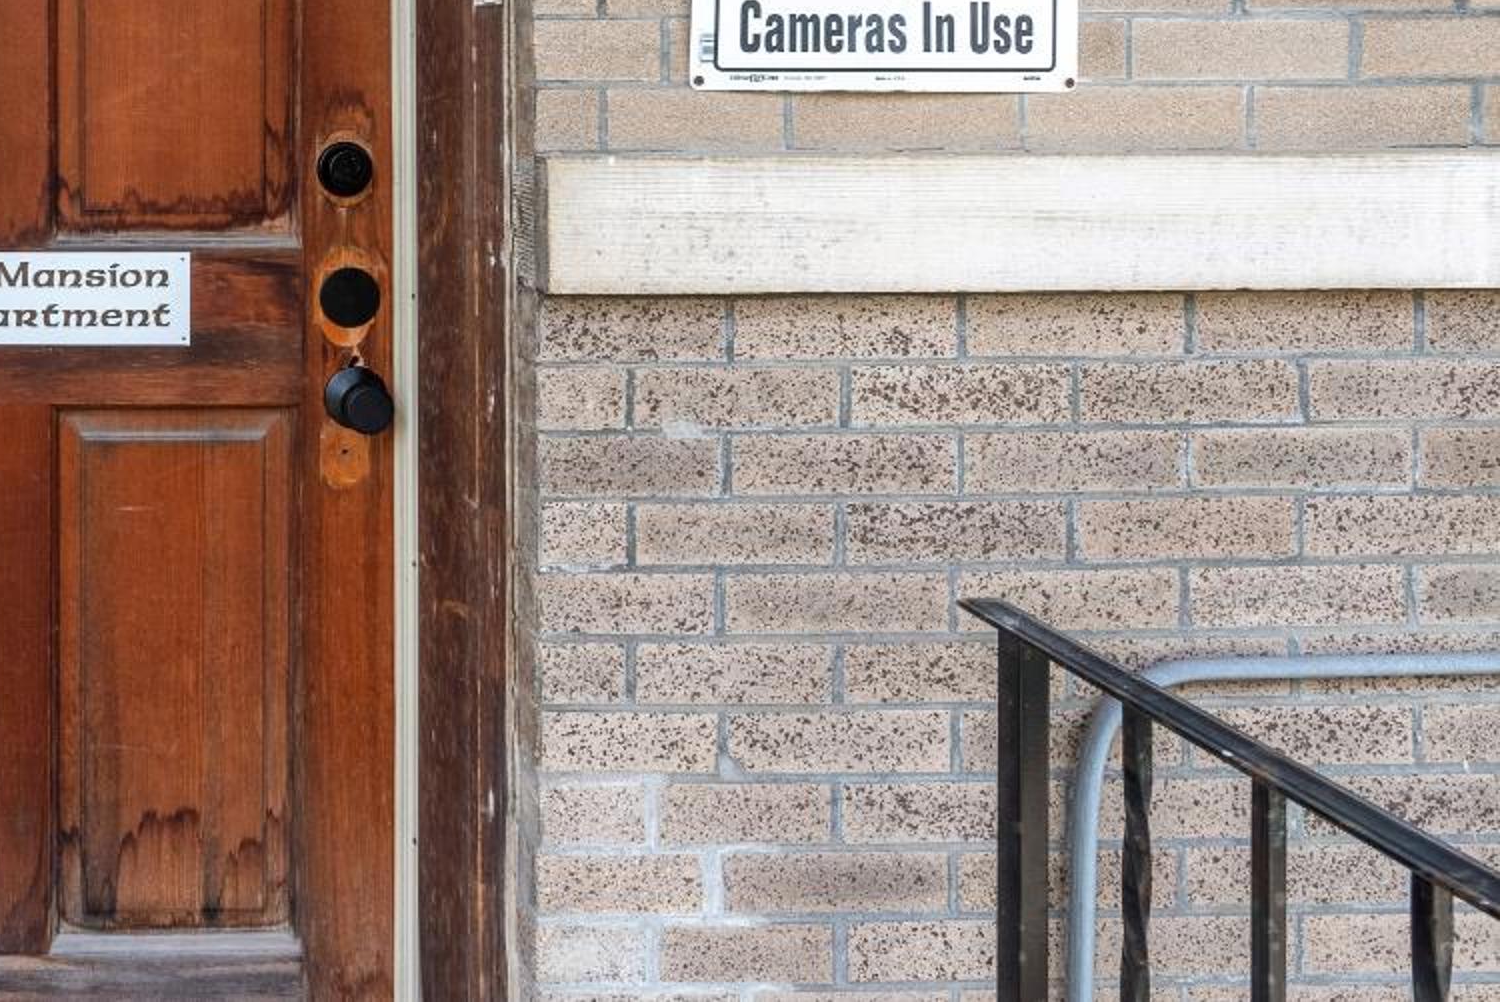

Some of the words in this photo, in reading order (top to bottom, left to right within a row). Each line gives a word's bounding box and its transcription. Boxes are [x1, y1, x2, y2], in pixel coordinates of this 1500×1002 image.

[739, 0, 907, 54] Cameras
[922, 1, 955, 53] In
[969, 1, 1034, 55] Use
